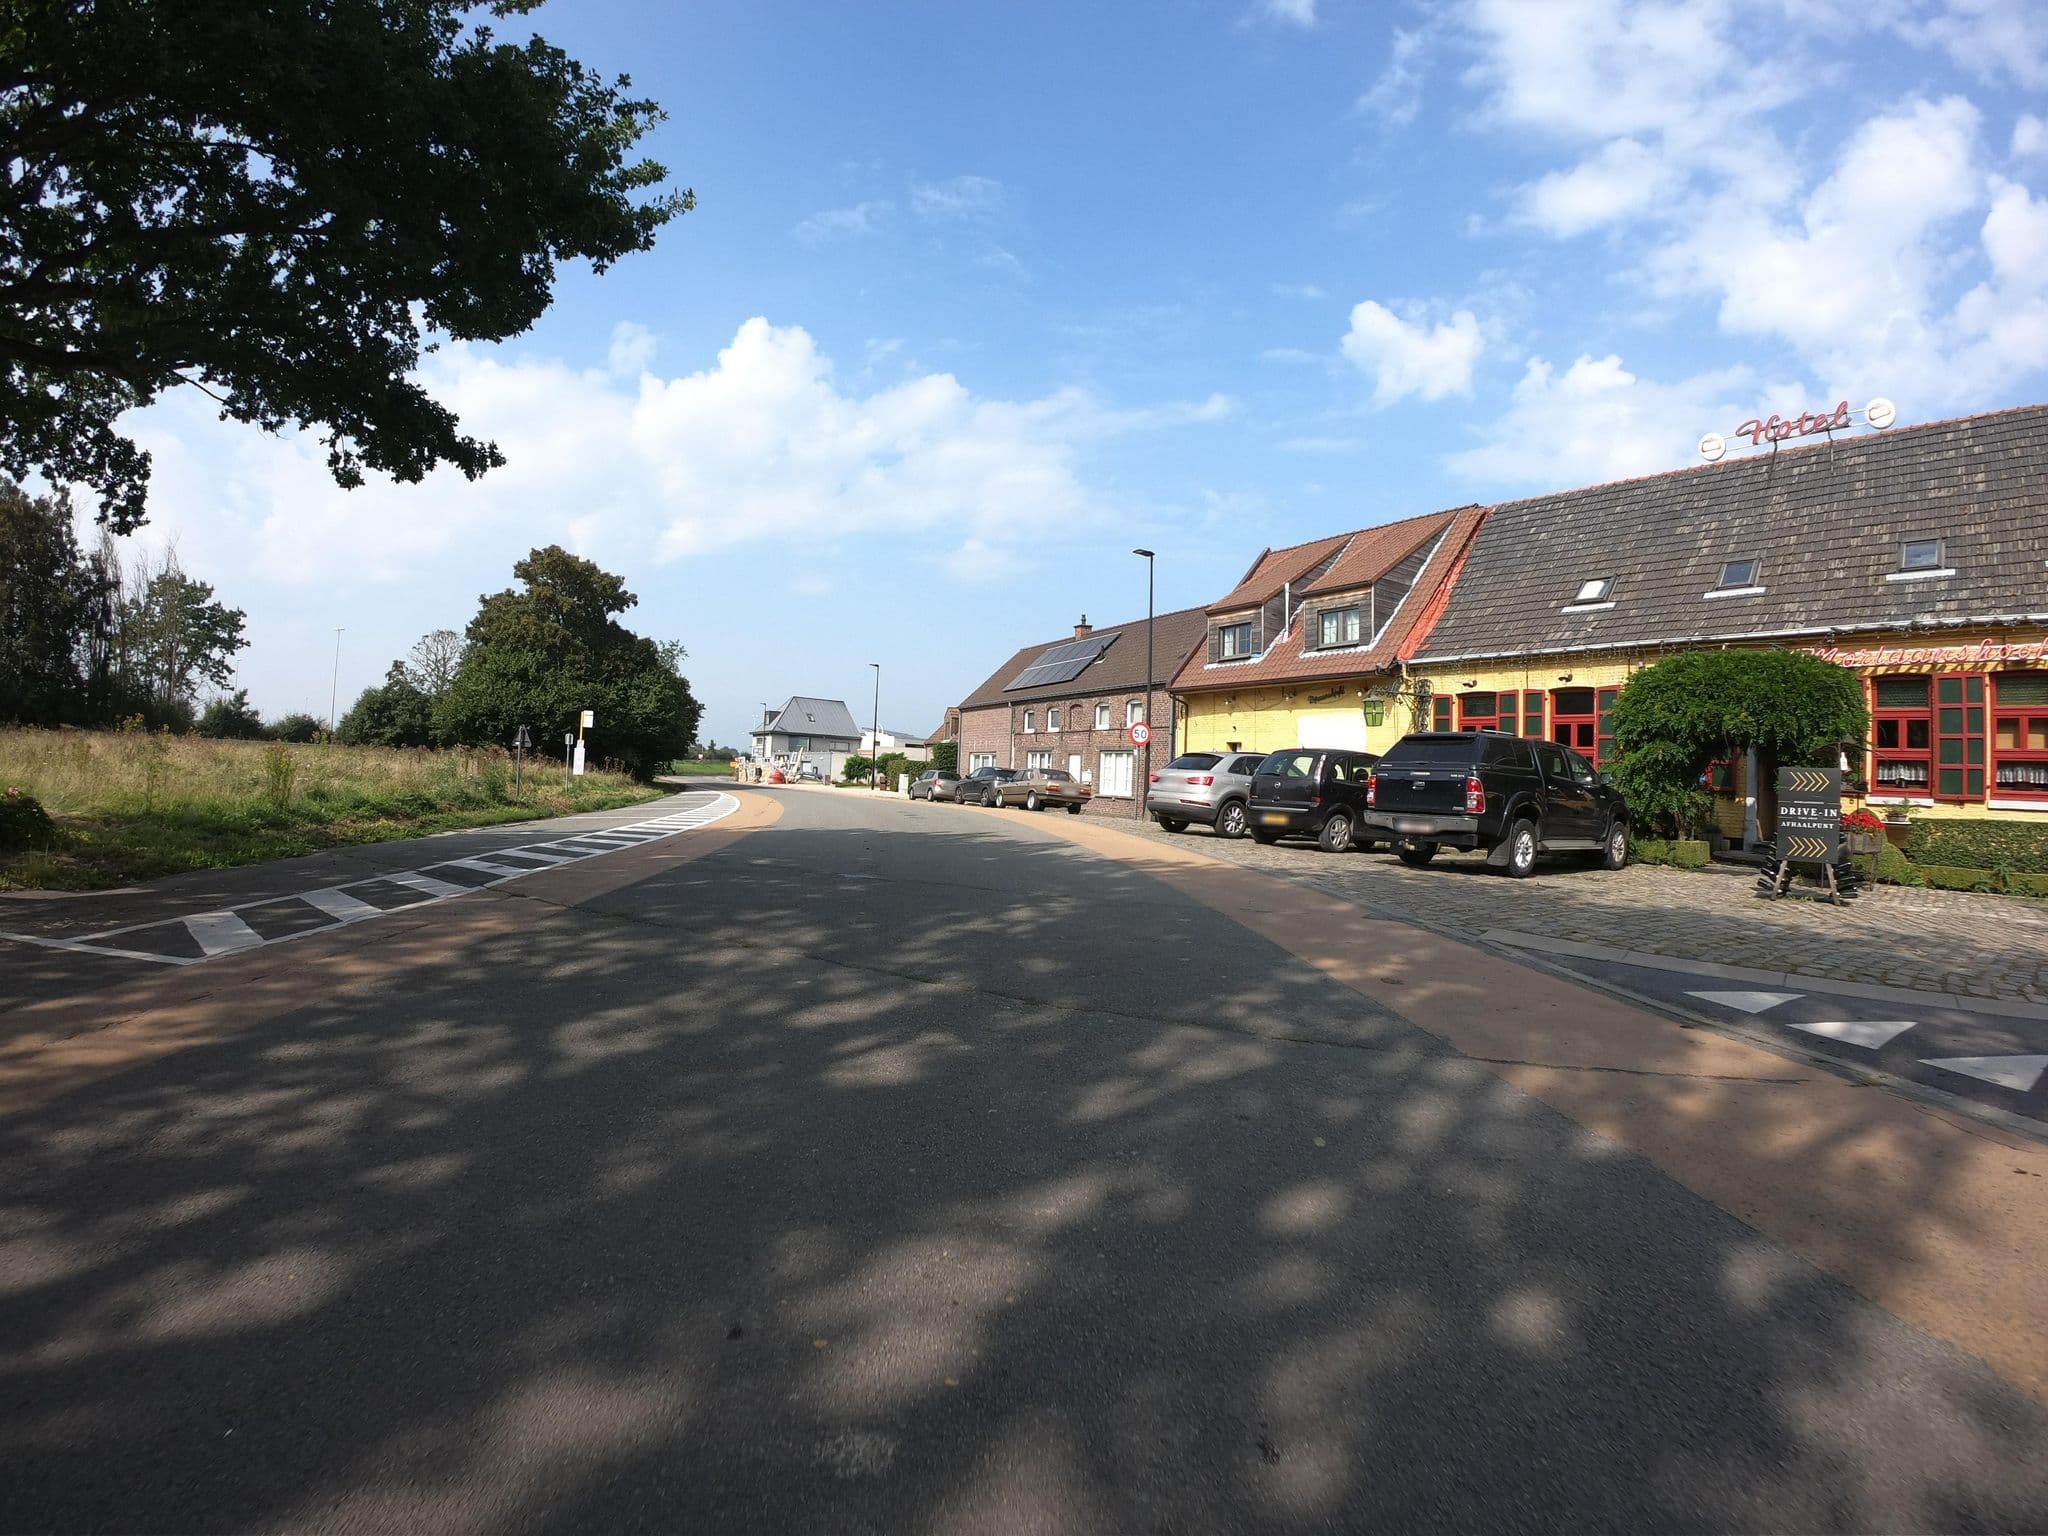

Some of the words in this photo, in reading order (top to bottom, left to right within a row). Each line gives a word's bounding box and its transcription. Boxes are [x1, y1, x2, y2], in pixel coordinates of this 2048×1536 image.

[1735, 400, 1852, 446] Hotel
[1134, 729, 1147, 739] 50
[1780, 807, 1838, 817] DRIVE-IN
[1780, 821, 1834, 830] AFHAALPUNT
